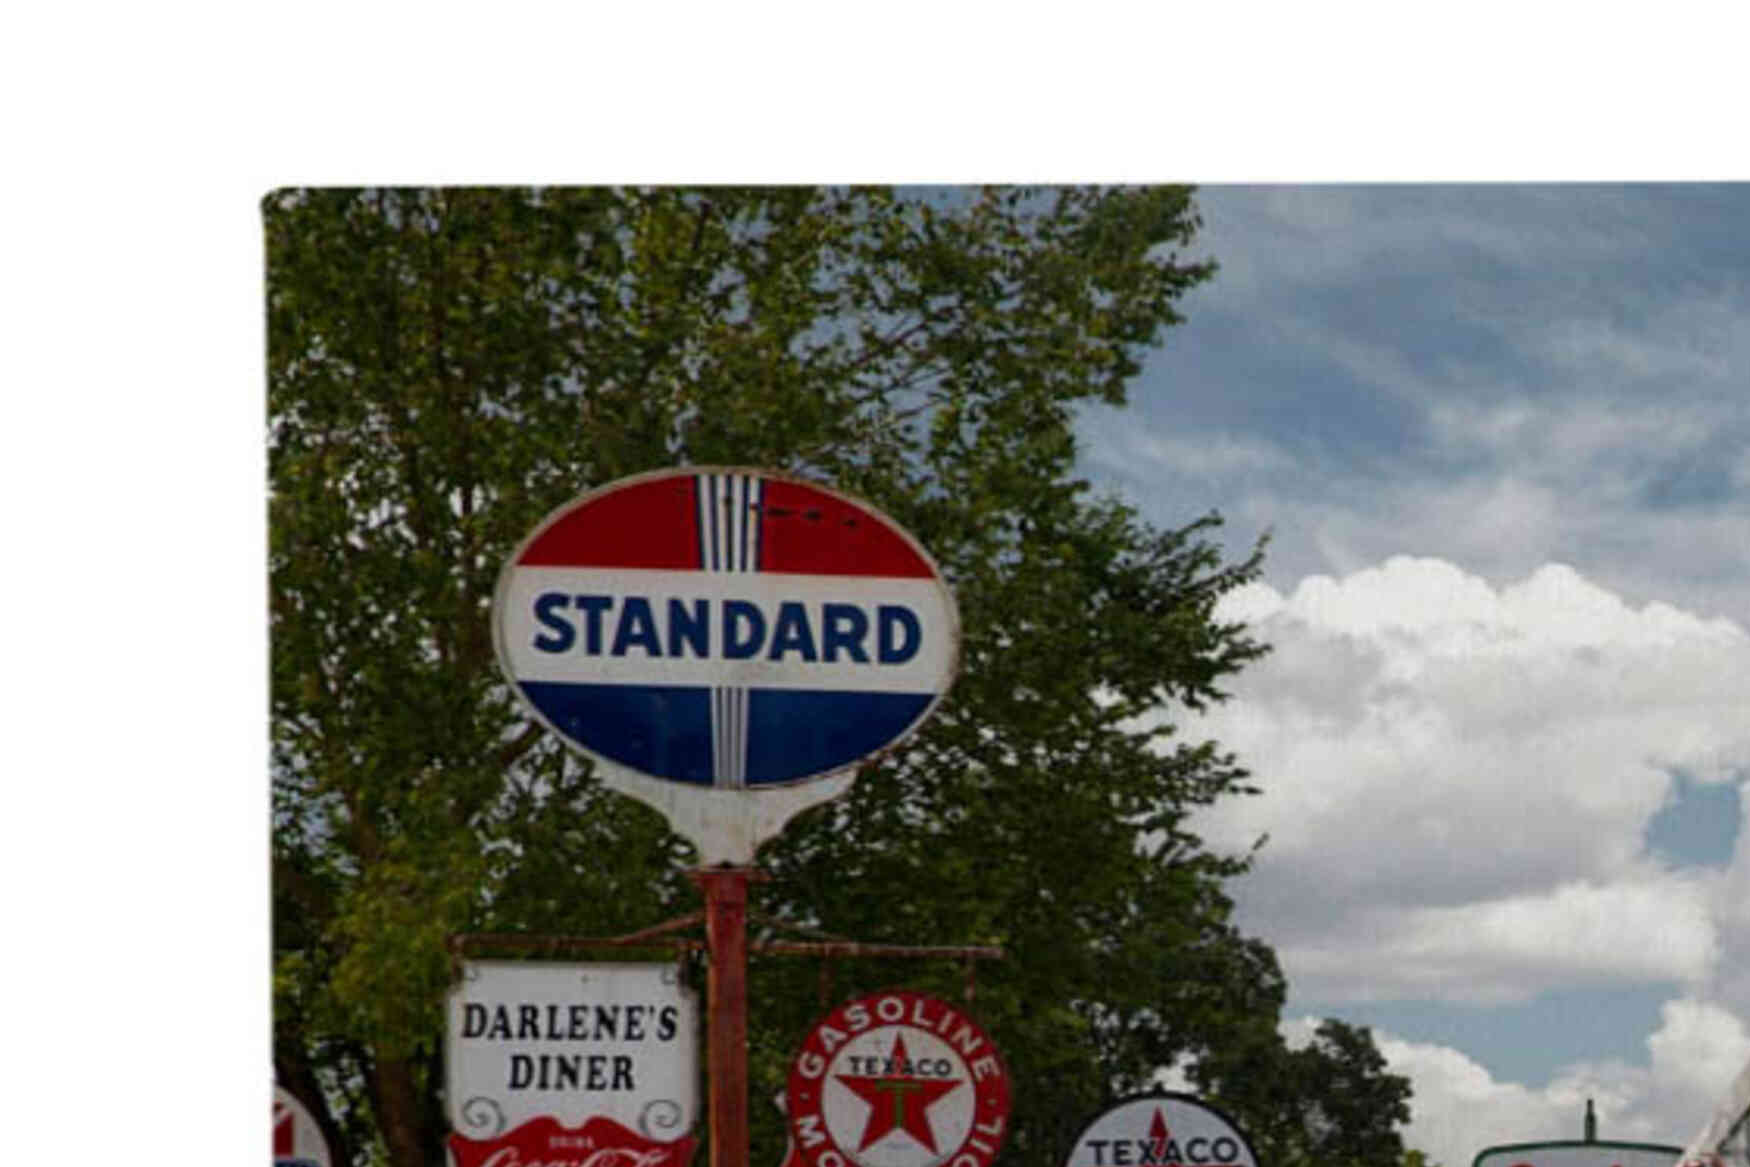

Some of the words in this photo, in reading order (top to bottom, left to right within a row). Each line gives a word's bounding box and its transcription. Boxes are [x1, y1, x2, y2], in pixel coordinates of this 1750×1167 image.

[533, 592, 922, 664] STANDARD
[460, 1002, 679, 1042] DARLENE'S
[799, 996, 1000, 1080] GASOLINE
[508, 1055, 637, 1092] DINER
[848, 1055, 953, 1077] TEXACO
[1086, 1136, 1240, 1167] TEXACO
